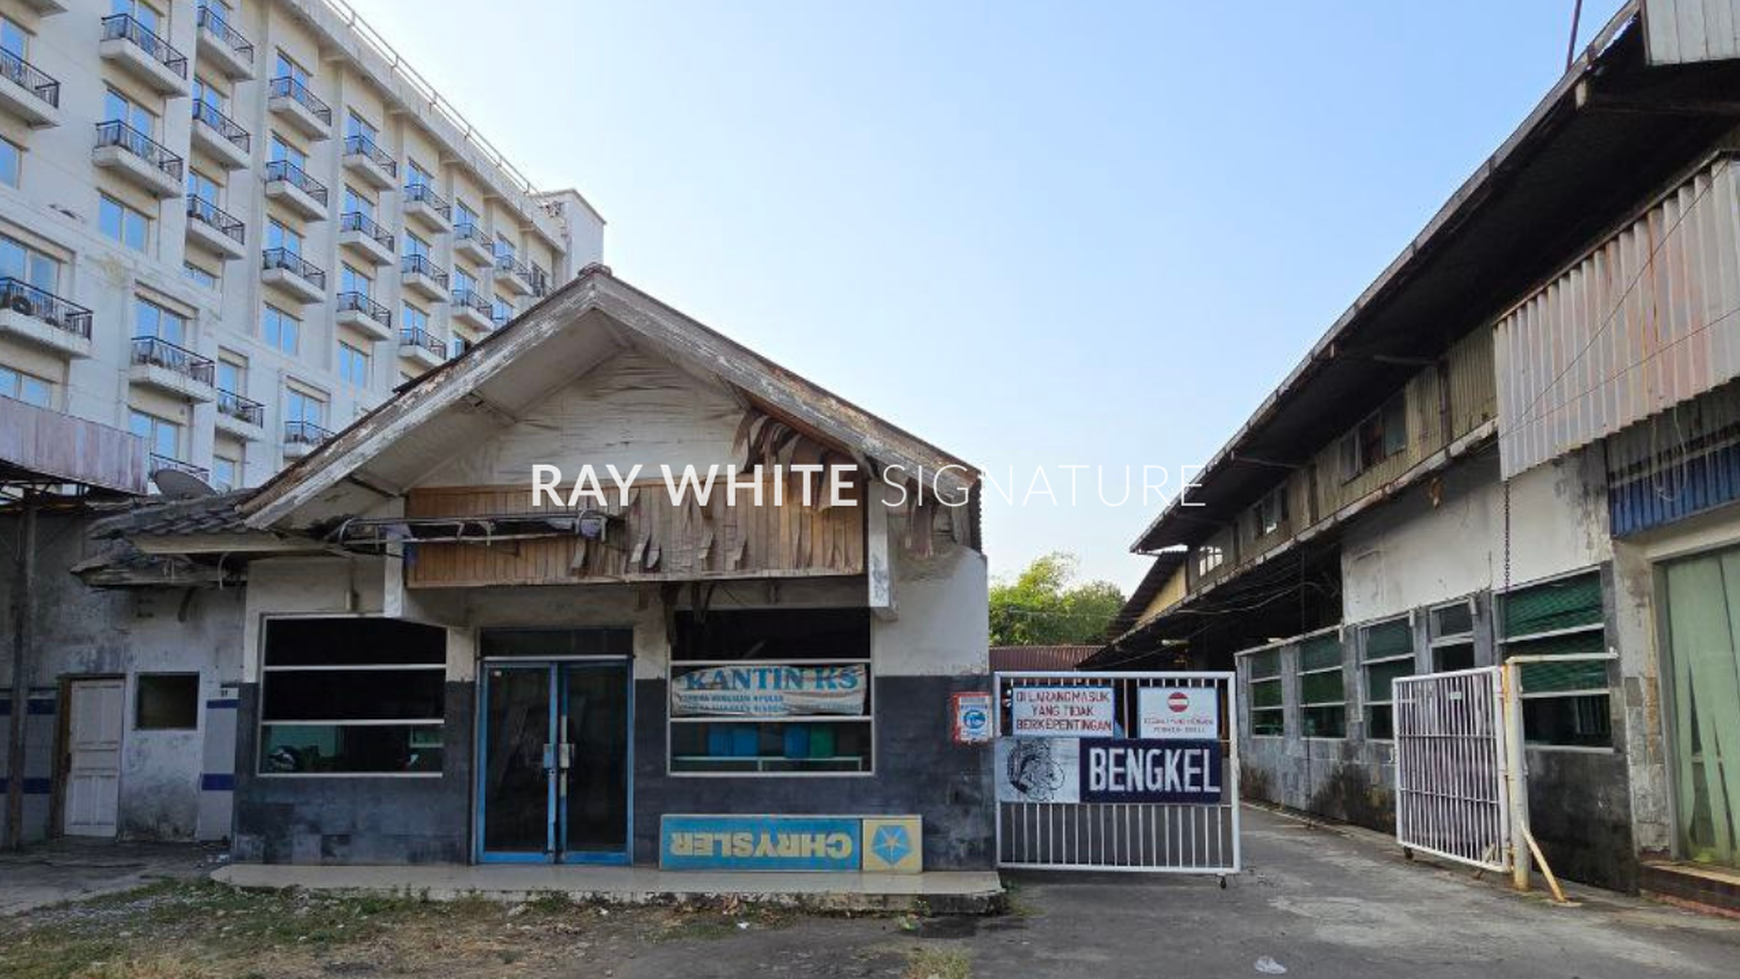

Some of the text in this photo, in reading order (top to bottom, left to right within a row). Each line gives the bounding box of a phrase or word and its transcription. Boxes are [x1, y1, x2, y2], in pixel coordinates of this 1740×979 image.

[685, 668, 804, 690] KANTIN
[1031, 705, 1094, 716] YANG TIDAK
[1016, 720, 1112, 731] BERKEPENTINGAN
[1089, 748, 1221, 793] BENGKEL
[670, 832, 853, 859] CHRYSLER
